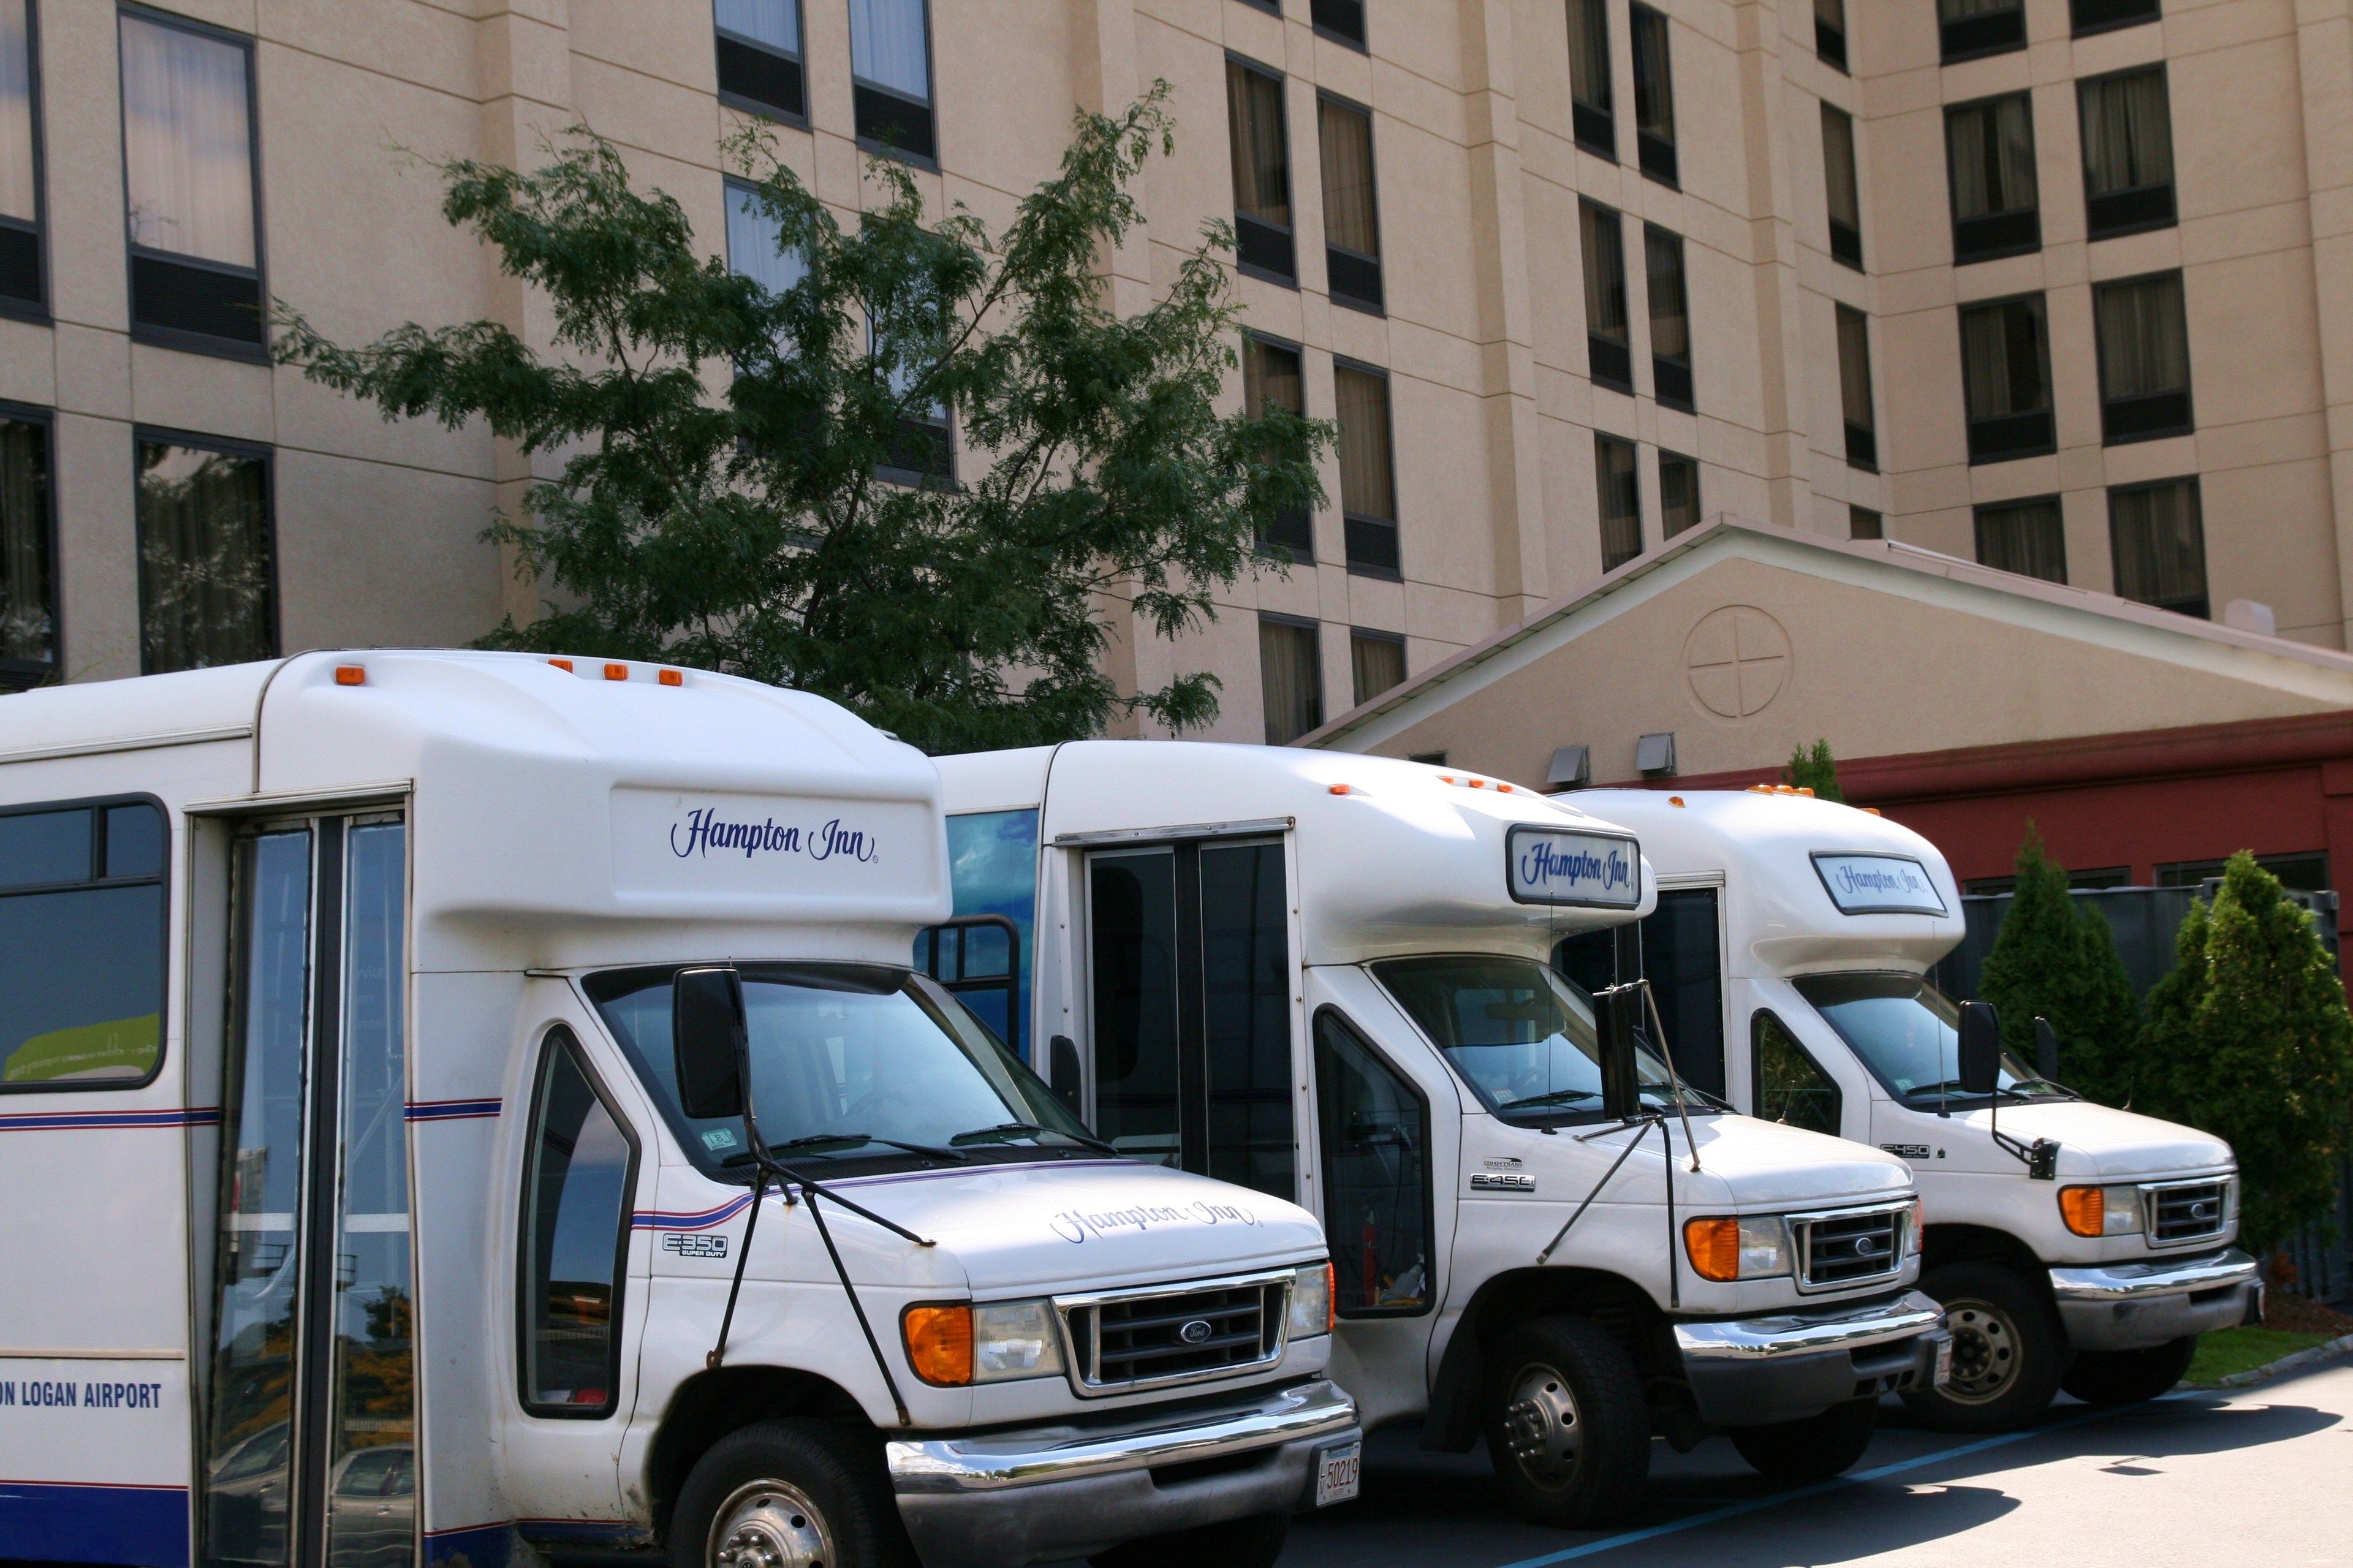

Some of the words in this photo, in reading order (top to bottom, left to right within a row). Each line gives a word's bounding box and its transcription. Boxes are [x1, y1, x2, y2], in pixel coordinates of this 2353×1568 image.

[671, 808, 801, 858] Hampton
[808, 819, 874, 862] Inn
[1522, 843, 1602, 886] Hampton
[1603, 850, 1633, 890] Inn
[1836, 865, 1896, 893] Hampton
[1897, 869, 1925, 893] Inn
[1049, 1205, 1188, 1244] Hampton
[1184, 1201, 1255, 1225] Inn
[0, 1381, 15, 1406] N
[22, 1381, 76, 1406] LOGAN
[83, 1382, 161, 1408] AIRPORT
[1327, 1458, 1358, 1489] 50219
